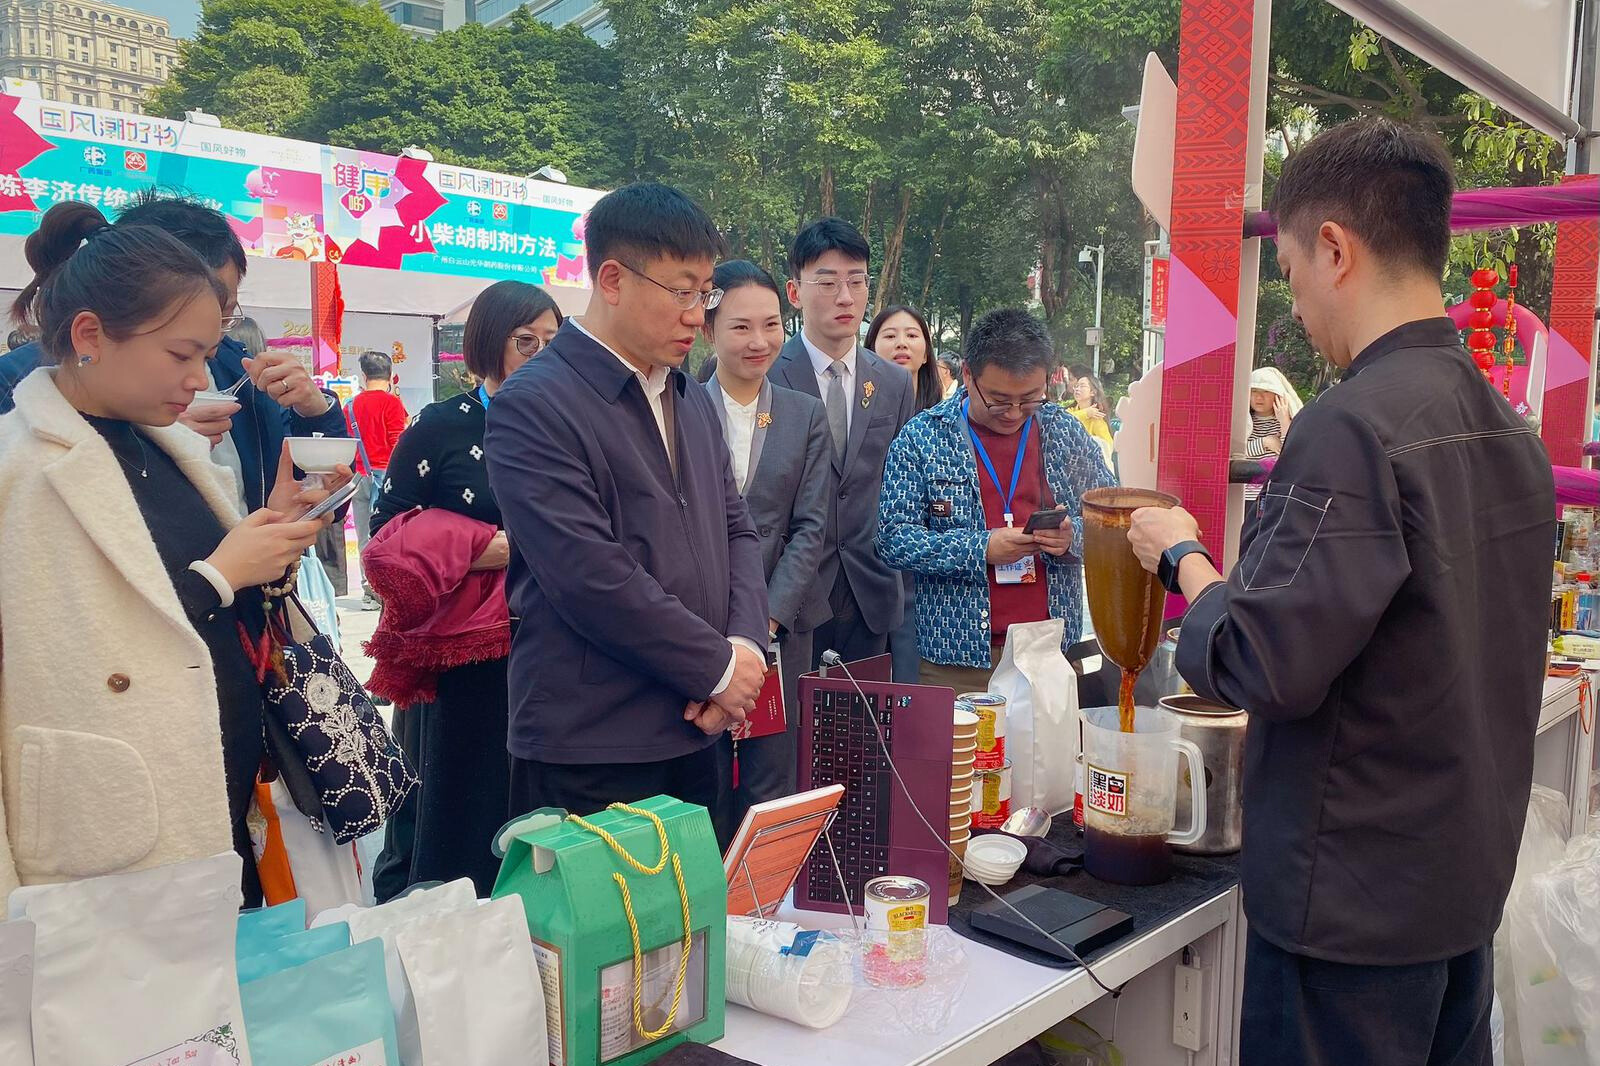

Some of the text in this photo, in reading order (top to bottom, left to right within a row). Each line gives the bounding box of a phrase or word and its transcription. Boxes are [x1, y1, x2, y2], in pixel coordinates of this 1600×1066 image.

[39, 106, 178, 148] 国风潮好物
[333, 163, 390, 198] 健康
[409, 219, 558, 258] 小柴胡制剂方法
